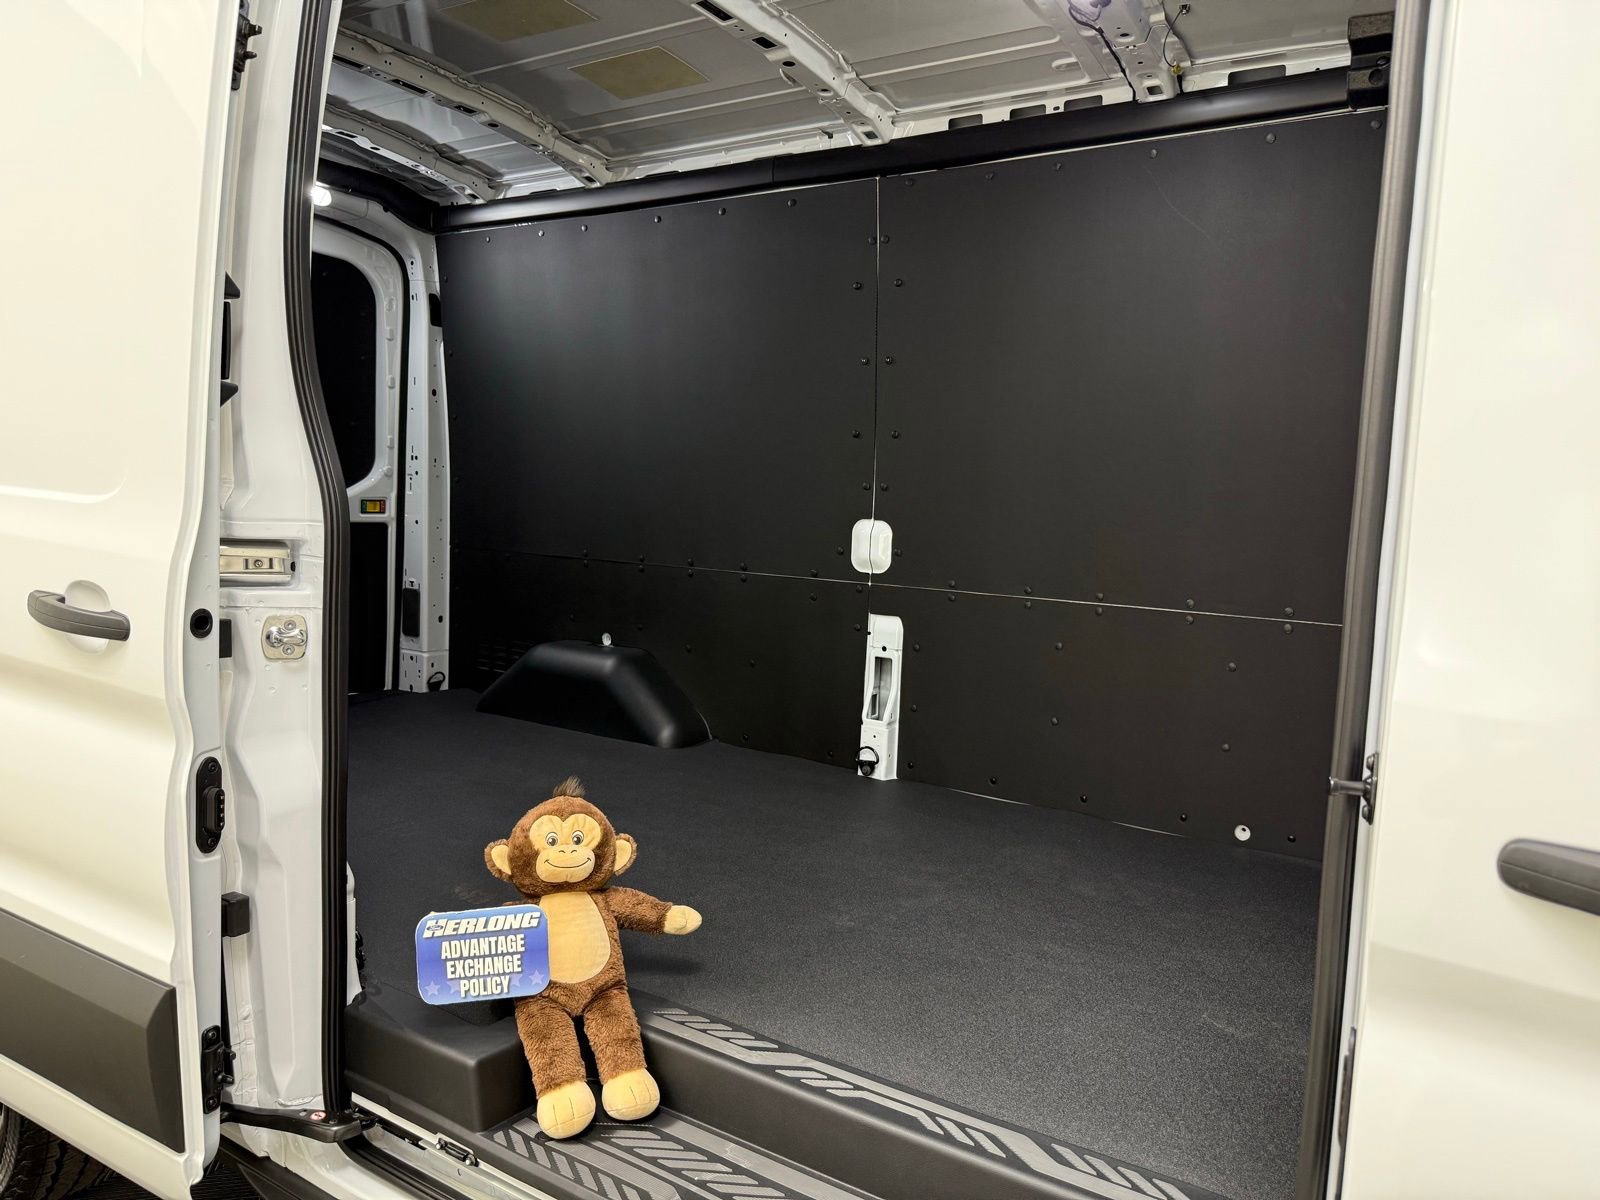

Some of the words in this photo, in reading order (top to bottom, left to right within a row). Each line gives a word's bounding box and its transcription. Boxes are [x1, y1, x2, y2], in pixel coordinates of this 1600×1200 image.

[423, 912, 541, 938] HERLONG
[441, 934, 525, 960] ADVANTAGE
[446, 954, 522, 979] EXCHANGE
[460, 976, 511, 998] POLICY
